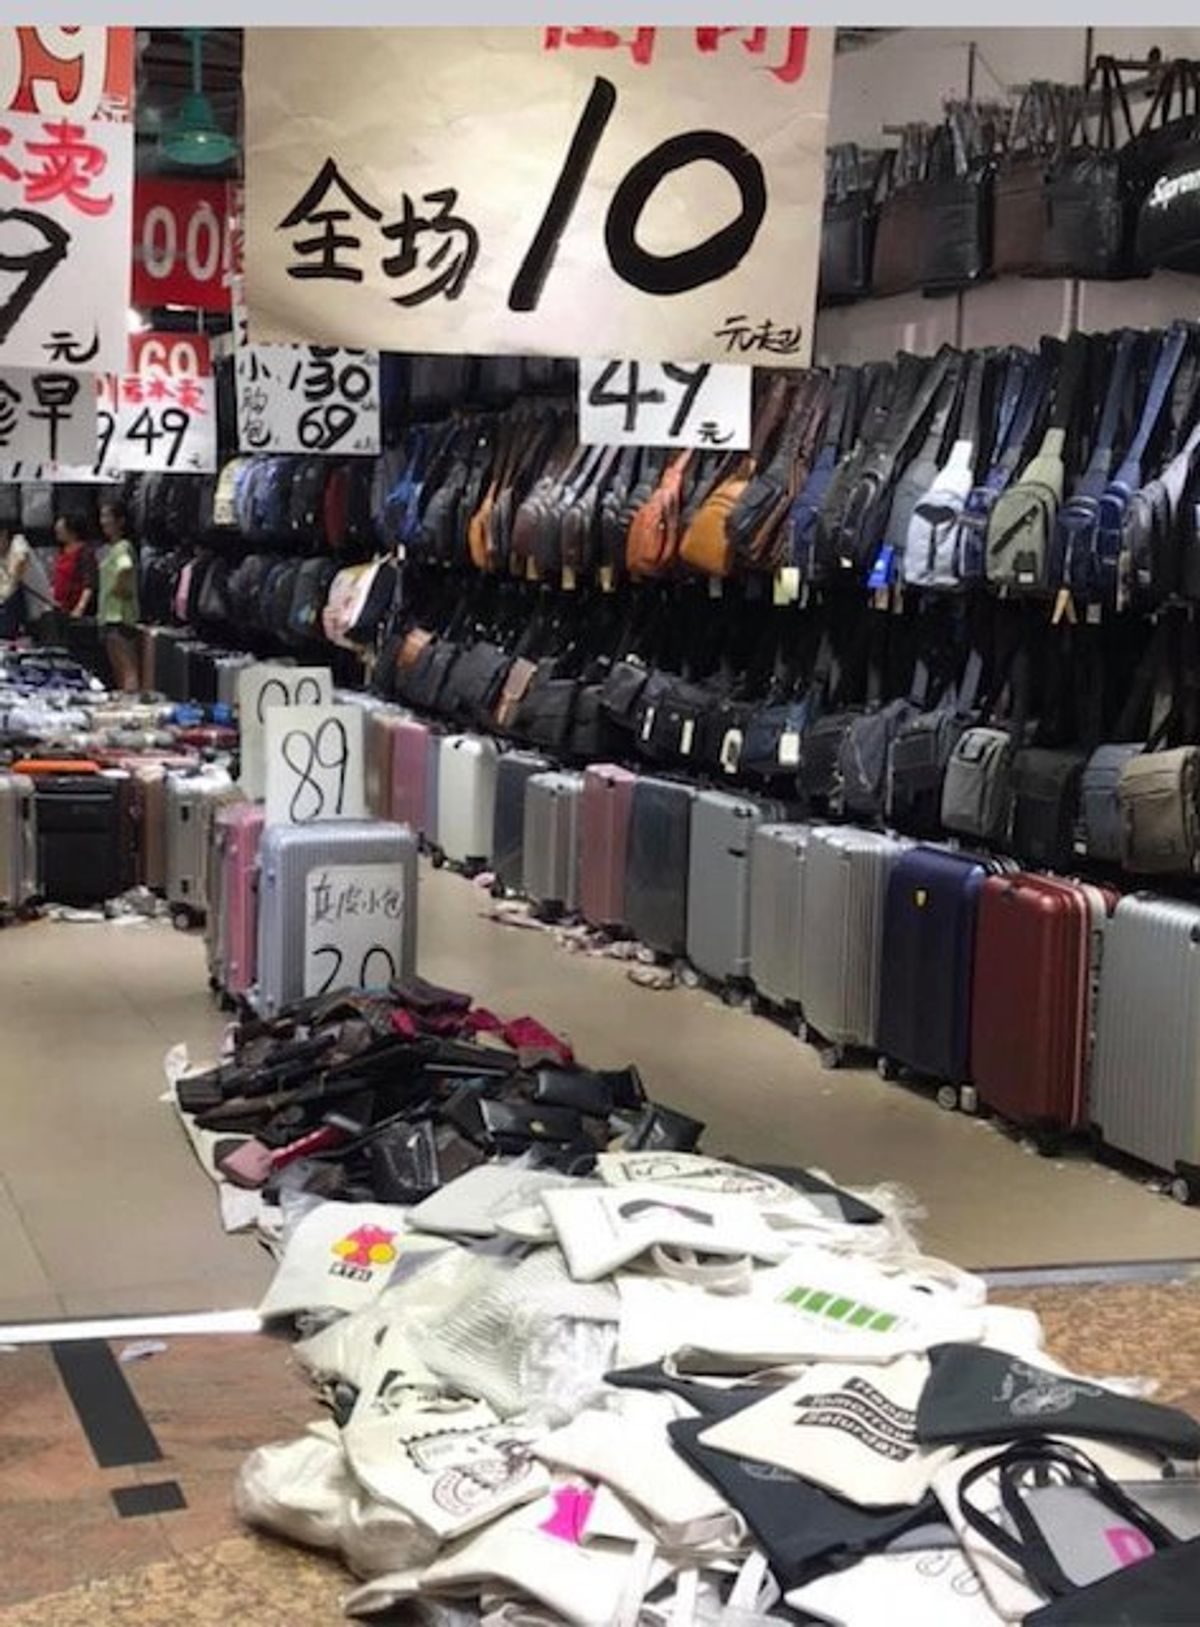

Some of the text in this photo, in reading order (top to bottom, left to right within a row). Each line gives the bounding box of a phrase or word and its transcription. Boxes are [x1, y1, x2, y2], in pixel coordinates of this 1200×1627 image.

[277, 75, 803, 354] 全场 10 元起
[42, 331, 99, 363] 元
[288, 360, 371, 402] 130
[125, 407, 190, 467] 49
[298, 403, 357, 450] 69
[698, 421, 736, 444] 元
[282, 716, 348, 825] 89
